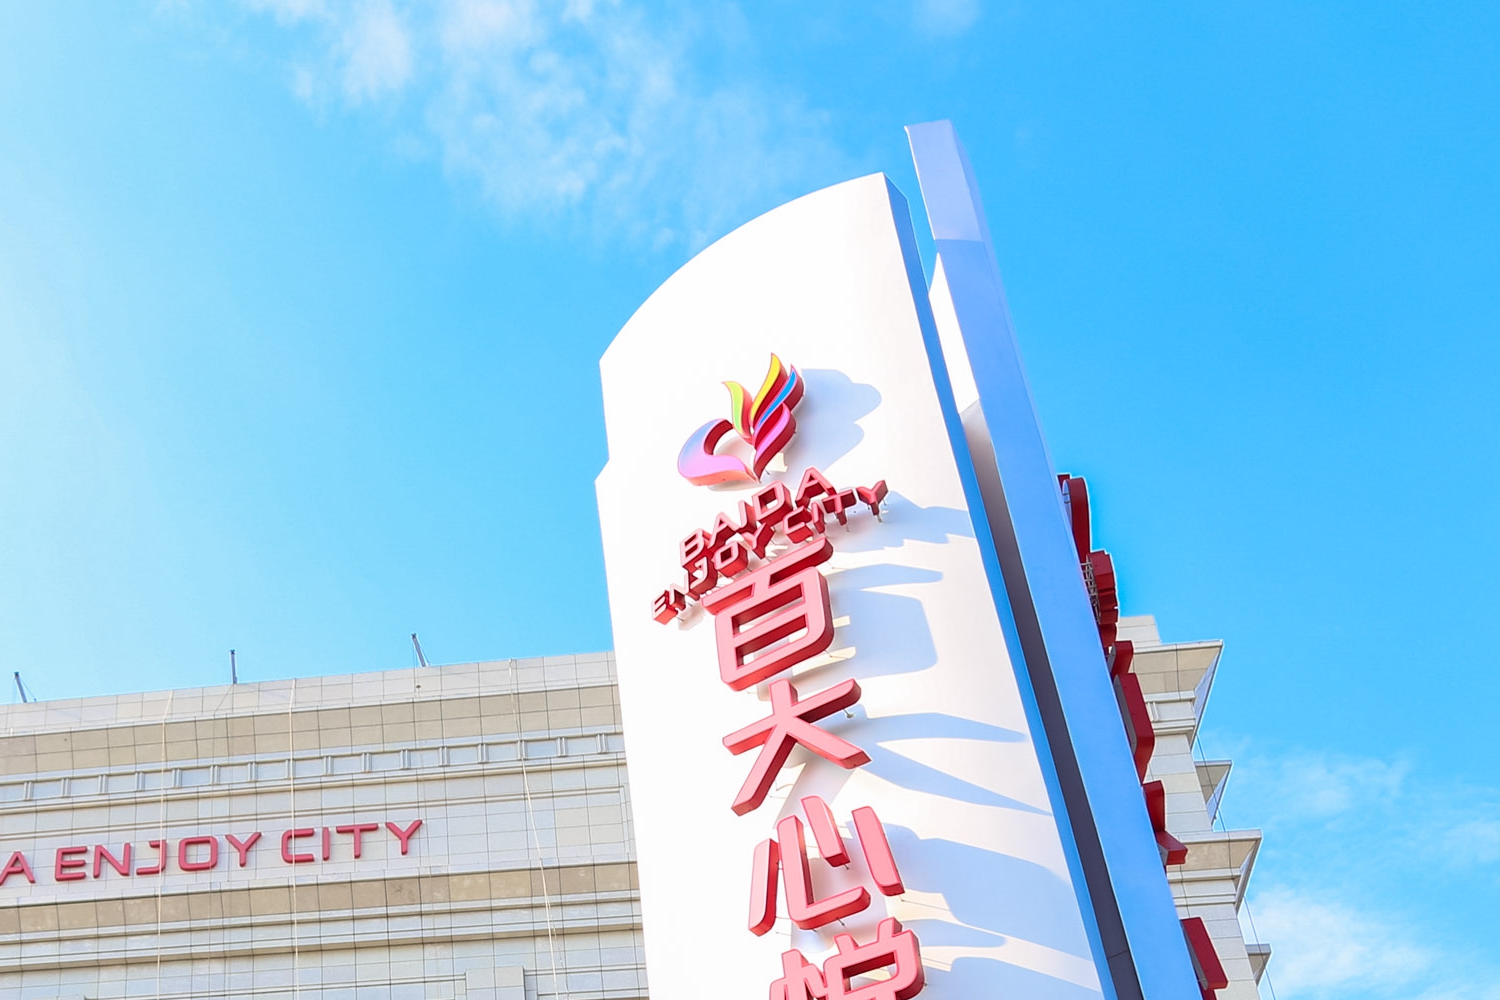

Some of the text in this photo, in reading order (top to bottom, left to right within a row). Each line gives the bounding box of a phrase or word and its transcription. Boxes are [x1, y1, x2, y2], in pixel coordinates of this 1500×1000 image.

[650, 479, 889, 625] ENJOY CITY
[679, 466, 838, 571] BAIDA
[54, 831, 263, 882] ENJOY
[281, 819, 424, 864] CITY
